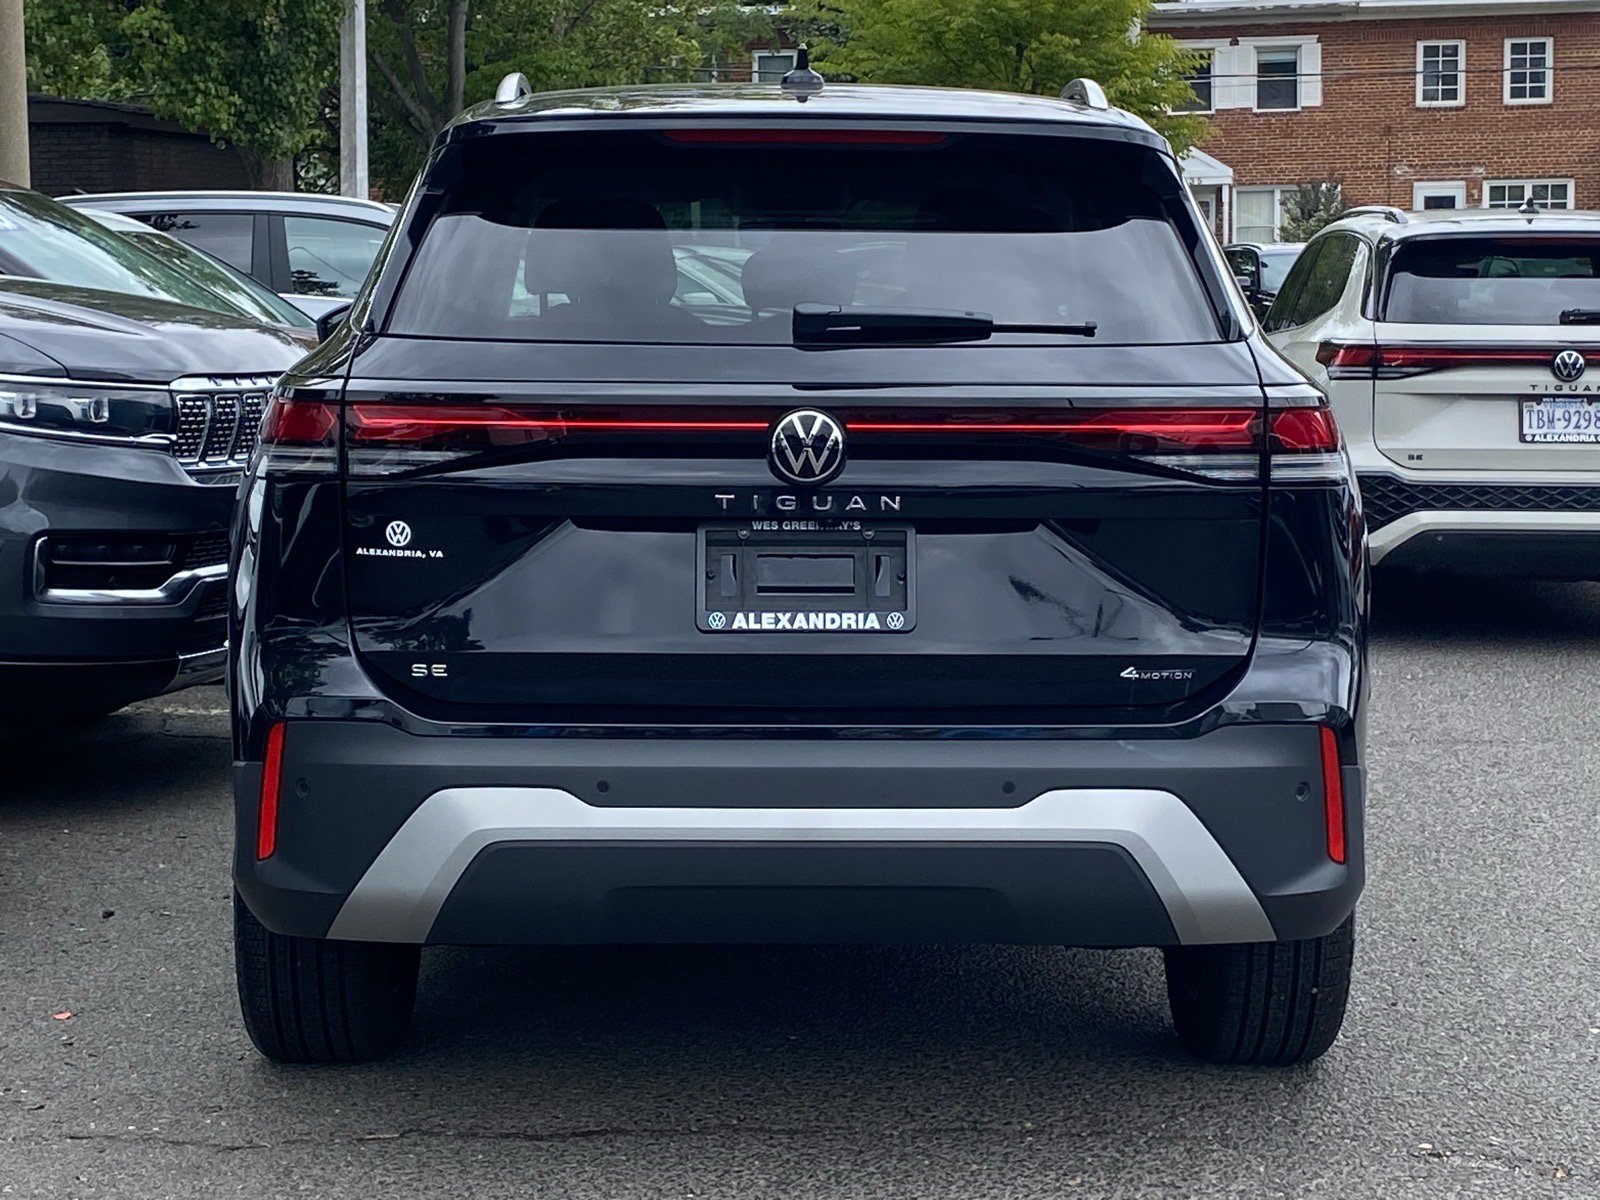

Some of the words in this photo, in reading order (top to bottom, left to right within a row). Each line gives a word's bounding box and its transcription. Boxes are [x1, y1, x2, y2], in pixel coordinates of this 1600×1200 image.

[772, 410, 843, 482] VW
[1534, 434, 1596, 442] ALEXANDRIA
[714, 494, 902, 512] TIGUAN
[385, 520, 412, 547] VW
[752, 521, 779, 531] WES
[782, 521, 862, 531] GREEY'S
[355, 547, 427, 559] ALEXANDRIA,
[429, 550, 444, 558] VA
[708, 612, 726, 629] VW
[731, 612, 881, 630] ALEXANDRIA
[886, 612, 904, 629] VW
[411, 663, 449, 677] SE
